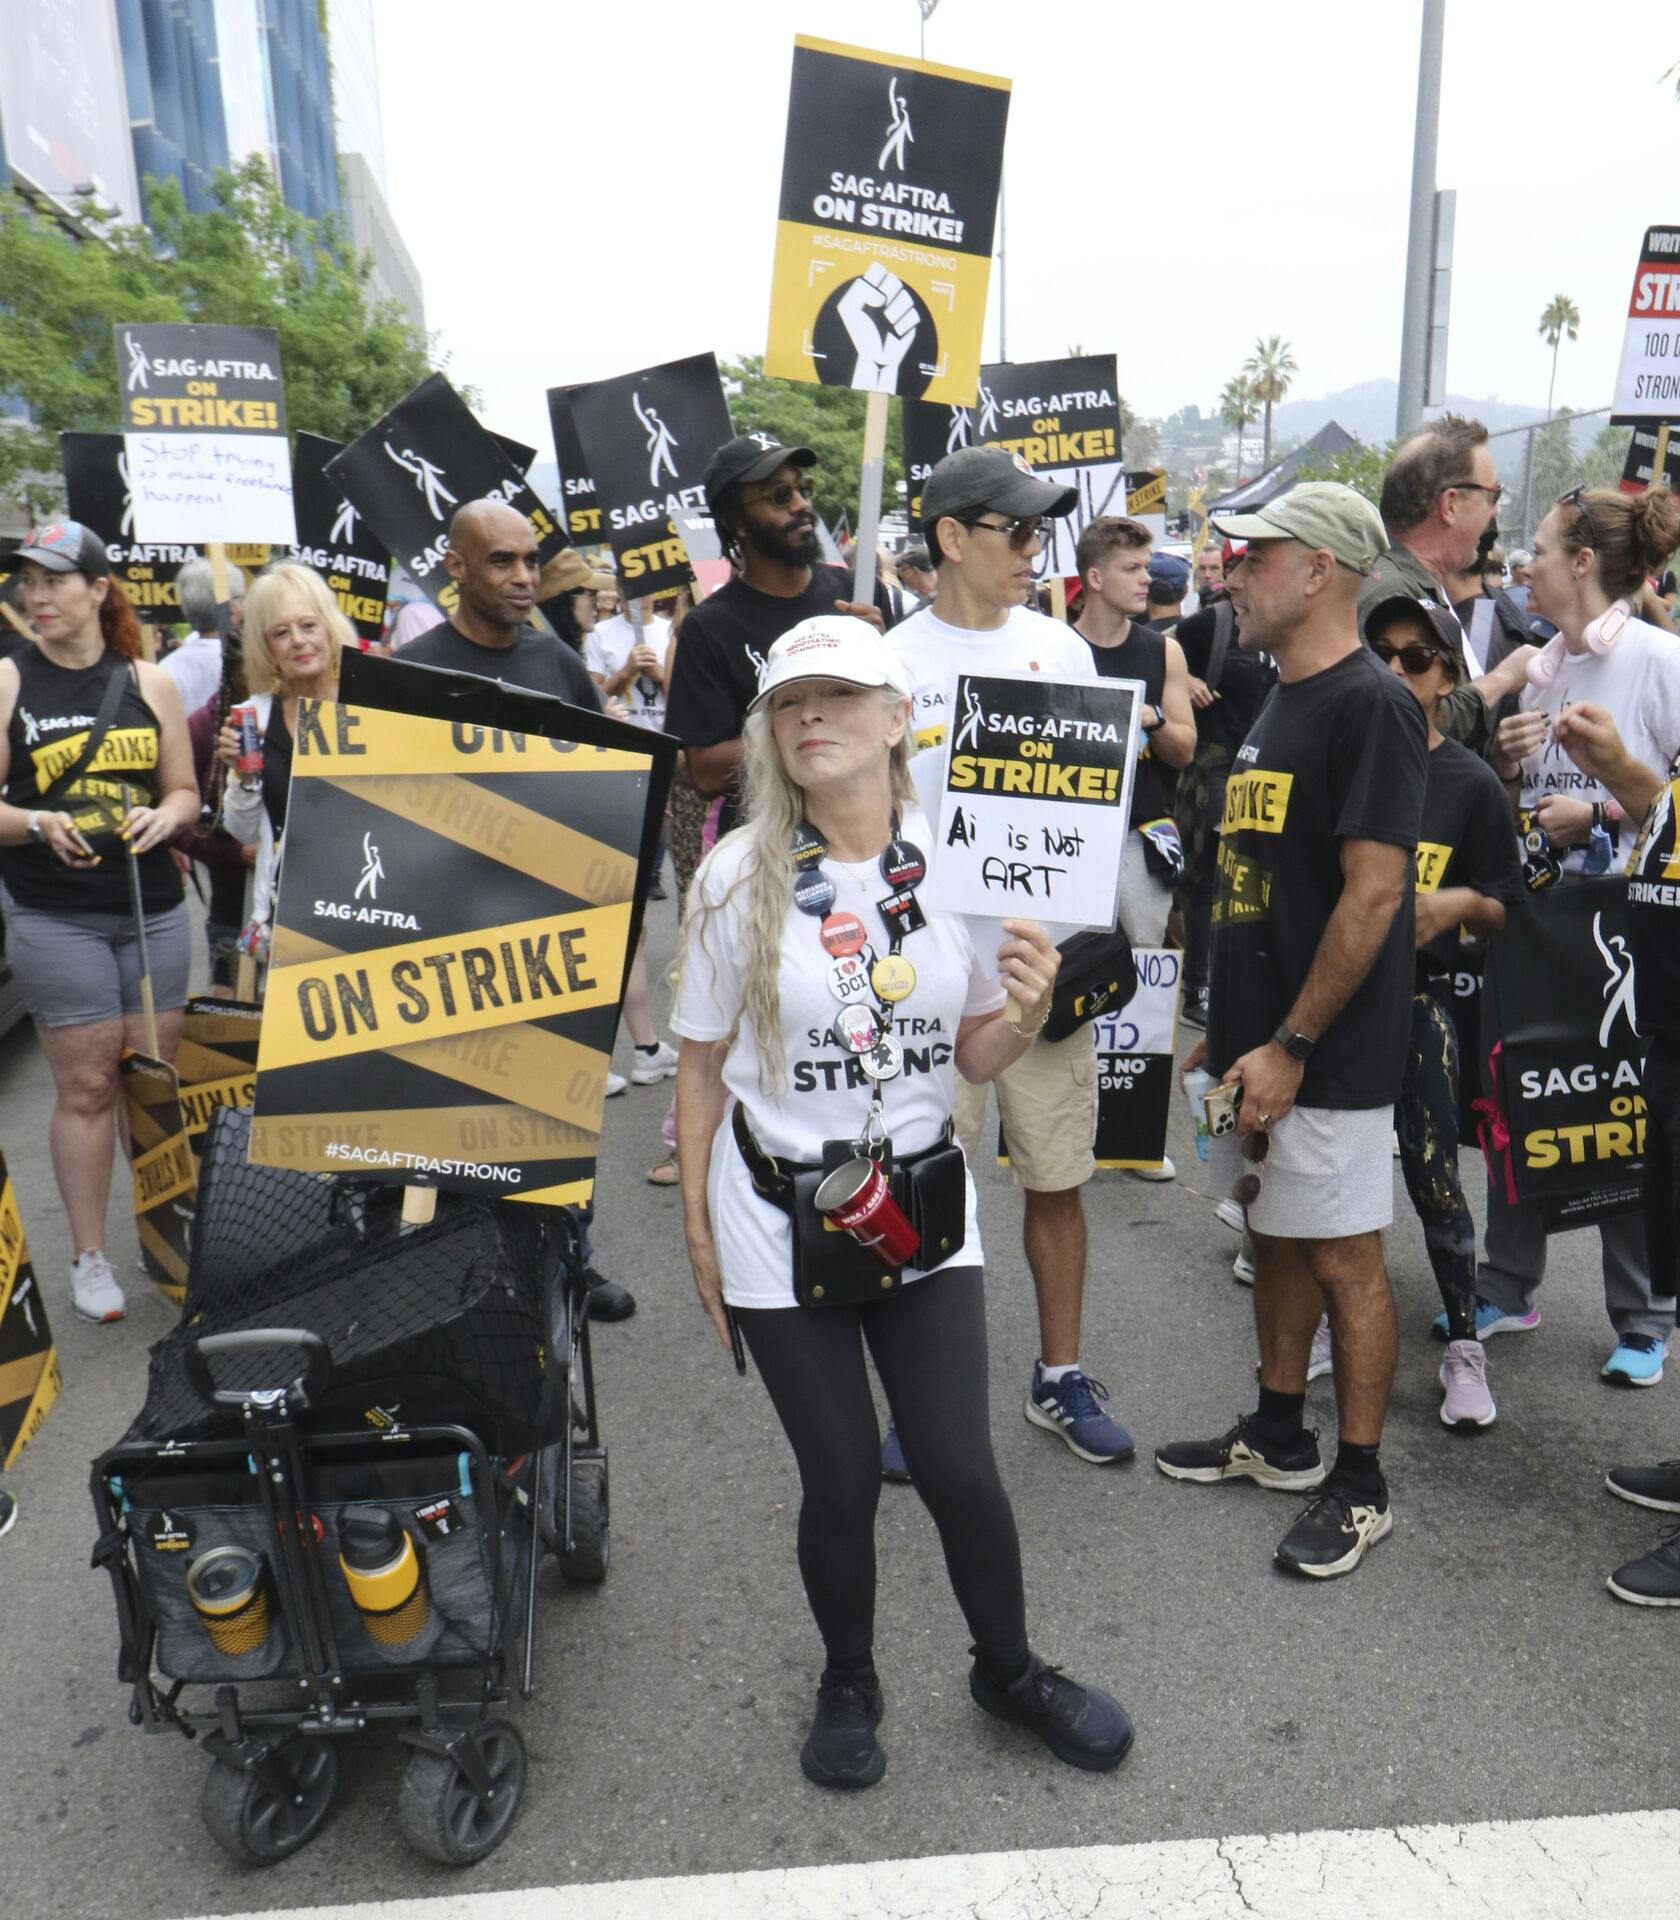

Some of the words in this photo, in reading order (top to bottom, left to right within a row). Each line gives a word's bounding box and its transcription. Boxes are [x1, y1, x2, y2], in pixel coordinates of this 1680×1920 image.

[813, 195, 855, 223] ON
[861, 203, 964, 244] STRIKE!
[811, 233, 958, 272] #SAGAFTRASTRONG
[1644, 333, 1669, 358] 100
[186, 381, 217, 396] ON
[1635, 375, 1680, 400] STRON
[129, 397, 279, 429] STRIKE!
[1032, 417, 1061, 435] ON
[140, 438, 201, 464] Stop
[213, 446, 275, 478] trying
[168, 472, 216, 481] make
[127, 566, 154, 580] ON
[328, 576, 351, 591] ON
[1019, 740, 1053, 759] ON
[949, 755, 1119, 801] STRIKE!
[947, 806, 976, 848] Ai
[1008, 824, 1028, 851] is
[1042, 826, 1084, 857] Not
[982, 856, 1067, 898] ART
[297, 969, 379, 1042] ON
[391, 927, 598, 1024] STRIKE
[833, 967, 844, 982] I
[837, 973, 867, 998] DCI
[1114, 1058, 1147, 1074] ON
[459, 1117, 499, 1151] ON
[324, 1142, 522, 1184] #SAGAFTRASTRONG
